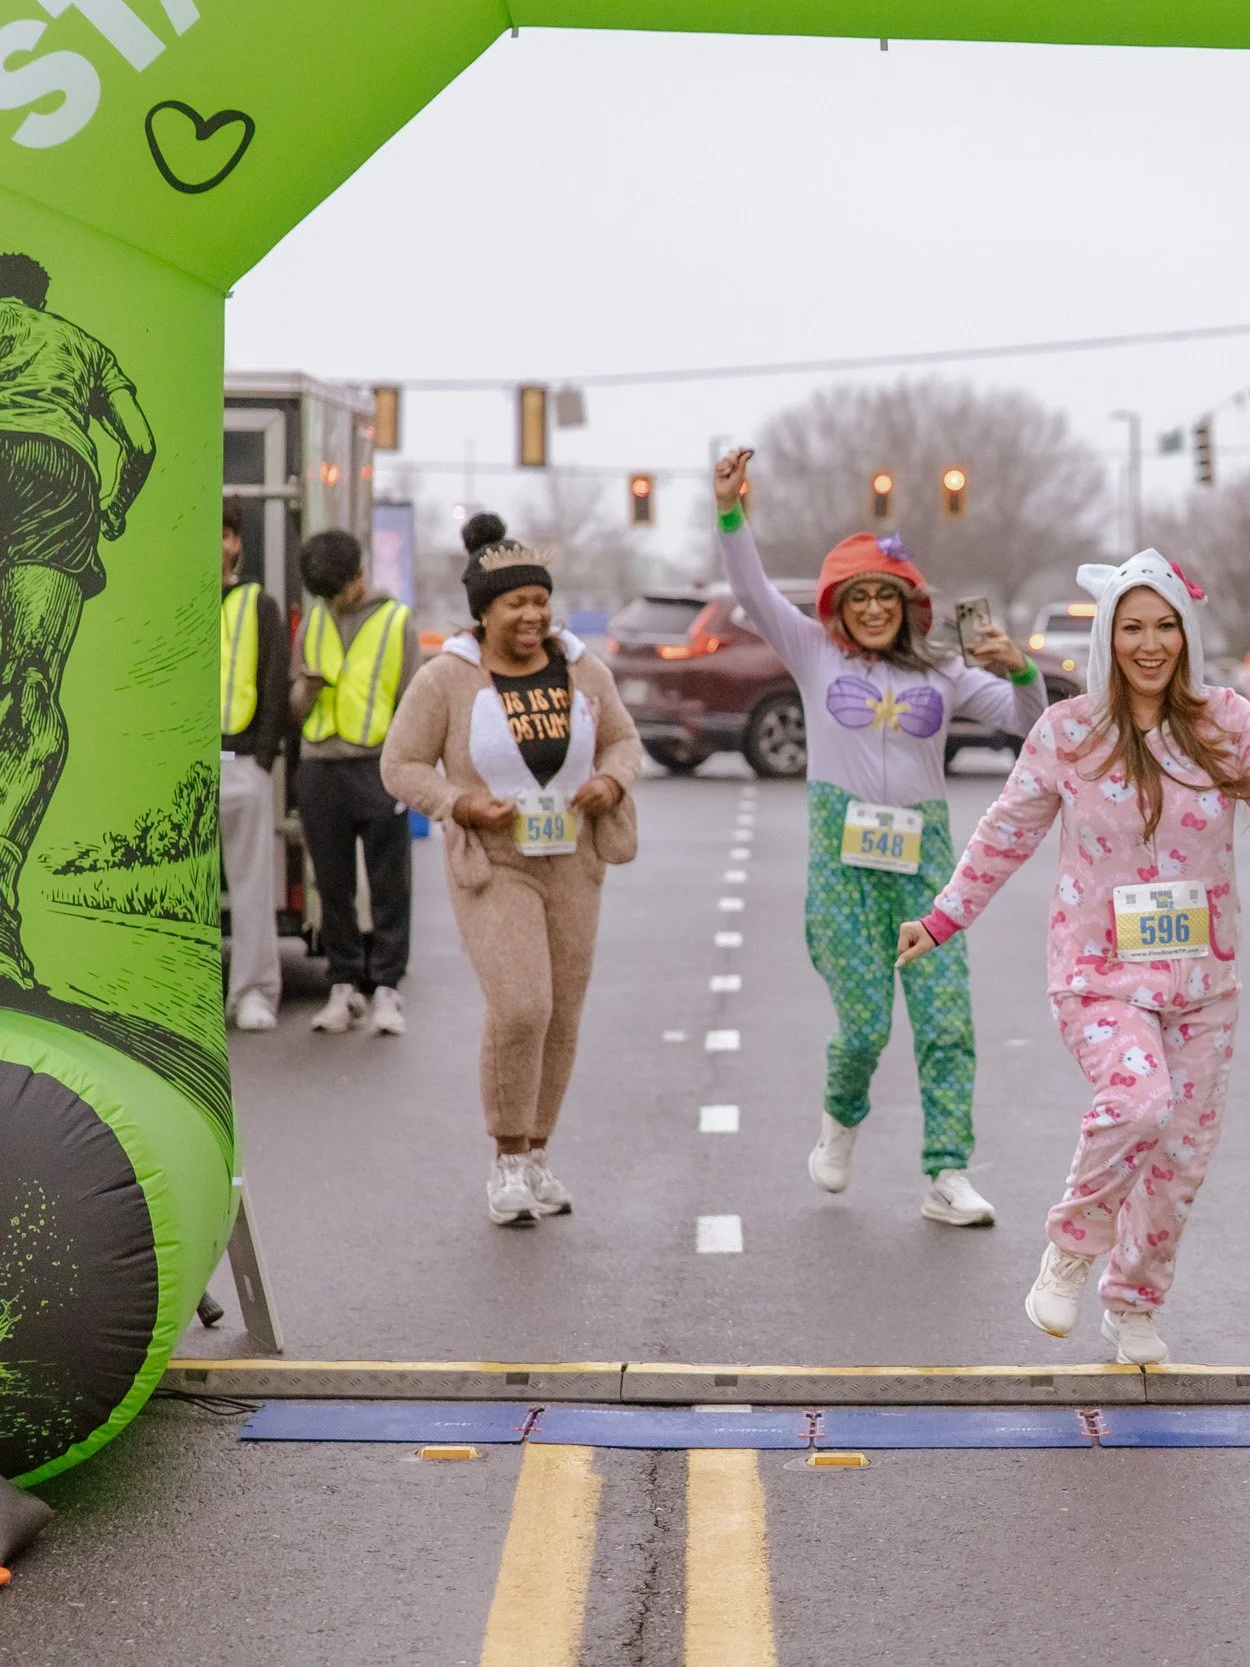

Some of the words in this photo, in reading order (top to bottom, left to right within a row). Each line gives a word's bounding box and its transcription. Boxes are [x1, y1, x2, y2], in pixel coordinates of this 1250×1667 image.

[0, 0, 201, 149] ST
[526, 688, 551, 712] IS
[548, 687, 571, 710] M
[527, 815, 564, 842] 549
[861, 829, 905, 858] 548
[1139, 913, 1190, 946] 596
